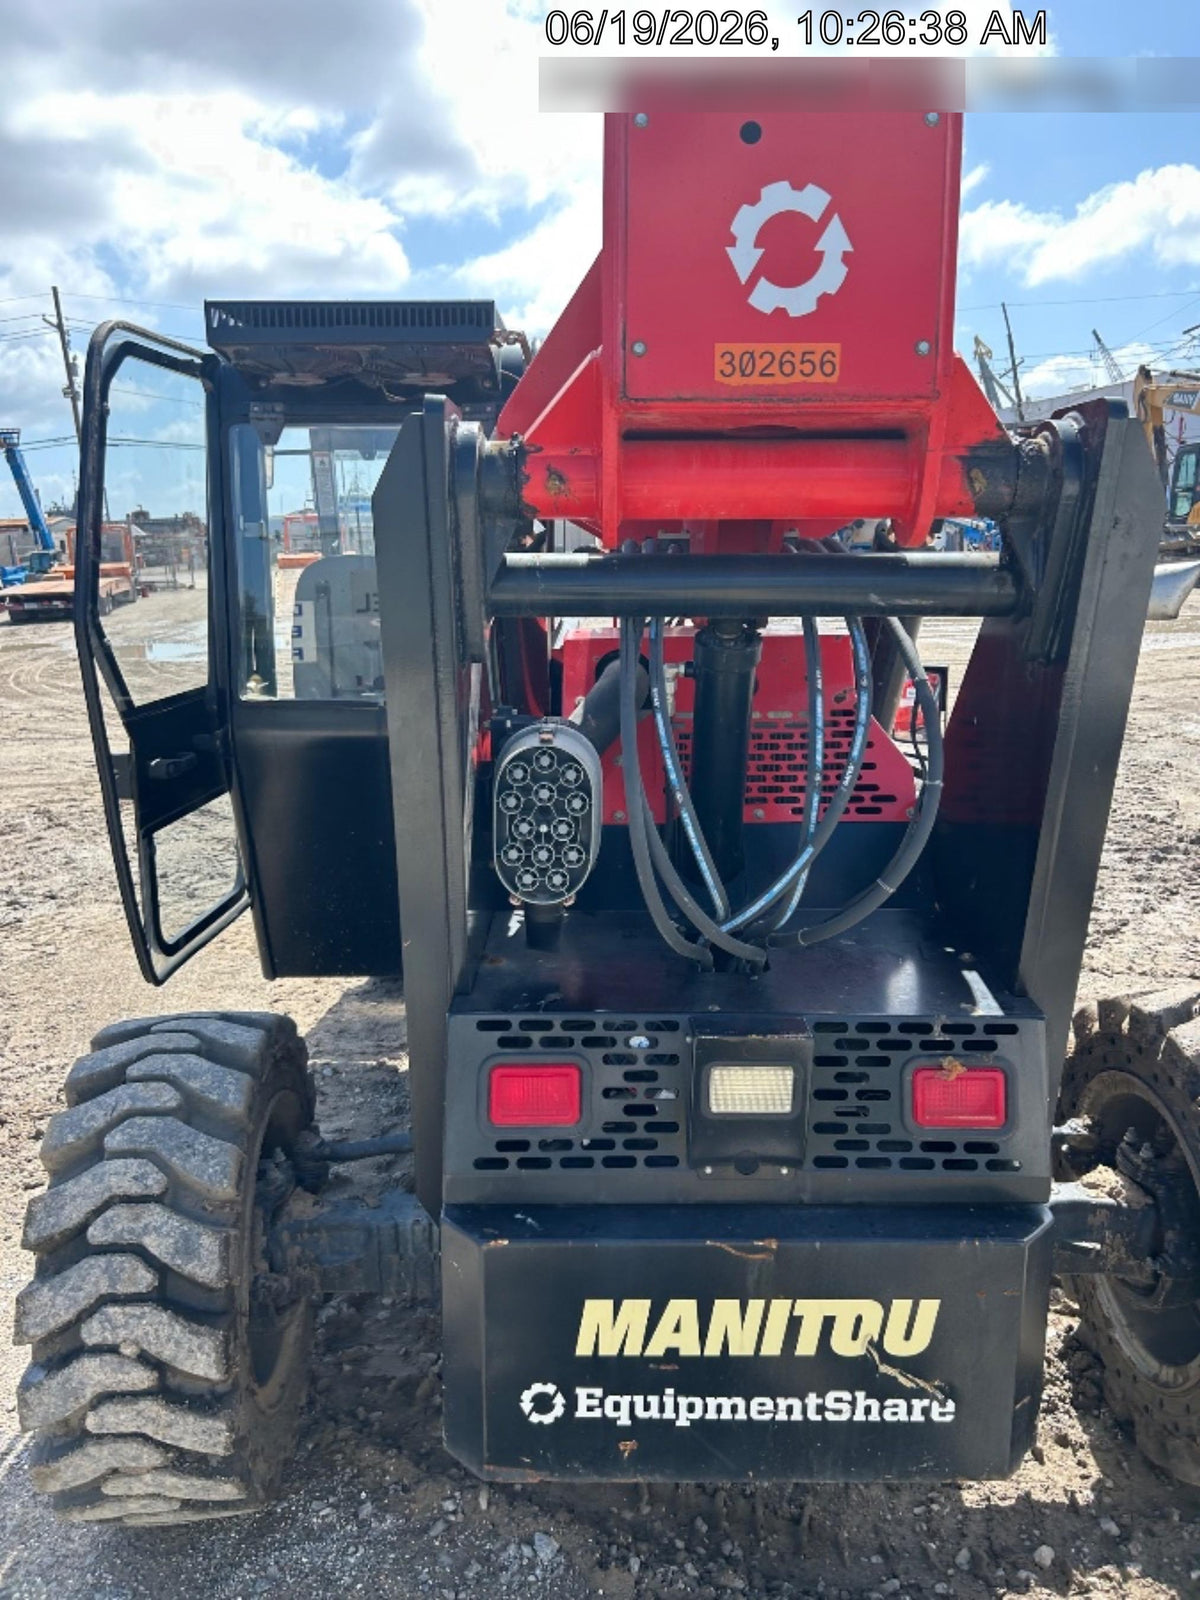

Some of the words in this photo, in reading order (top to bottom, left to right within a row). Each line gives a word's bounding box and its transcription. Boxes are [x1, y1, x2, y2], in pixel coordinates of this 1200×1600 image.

[719, 349, 837, 378] 302656
[576, 1299, 940, 1357] MANITOU
[575, 1387, 955, 1425] EquipmentShare
